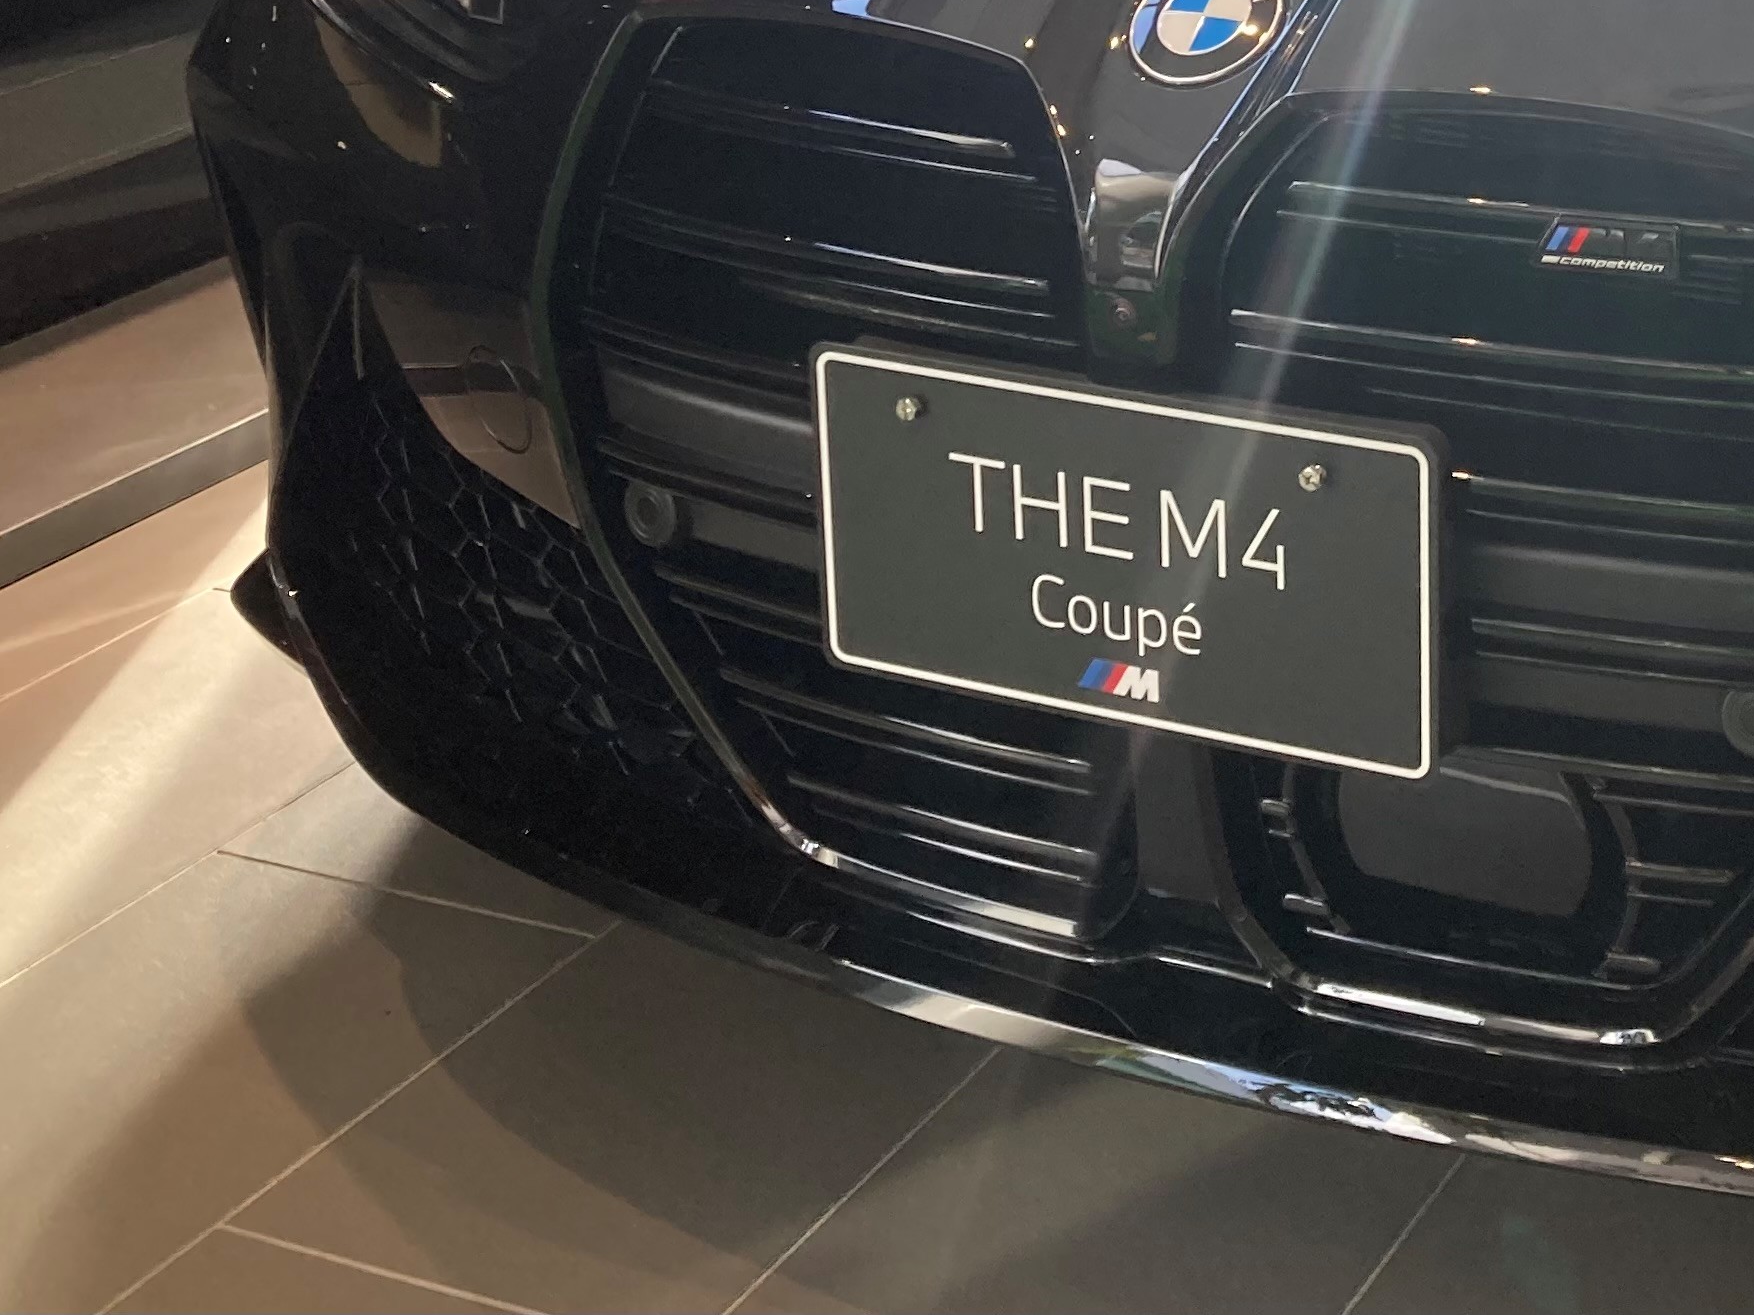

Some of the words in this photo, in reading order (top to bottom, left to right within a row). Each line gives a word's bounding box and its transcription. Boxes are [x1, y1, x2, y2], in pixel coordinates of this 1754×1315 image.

[948, 451, 1134, 562] THE
[1159, 488, 1286, 591] M4
[1031, 573, 1203, 657] Coupé
